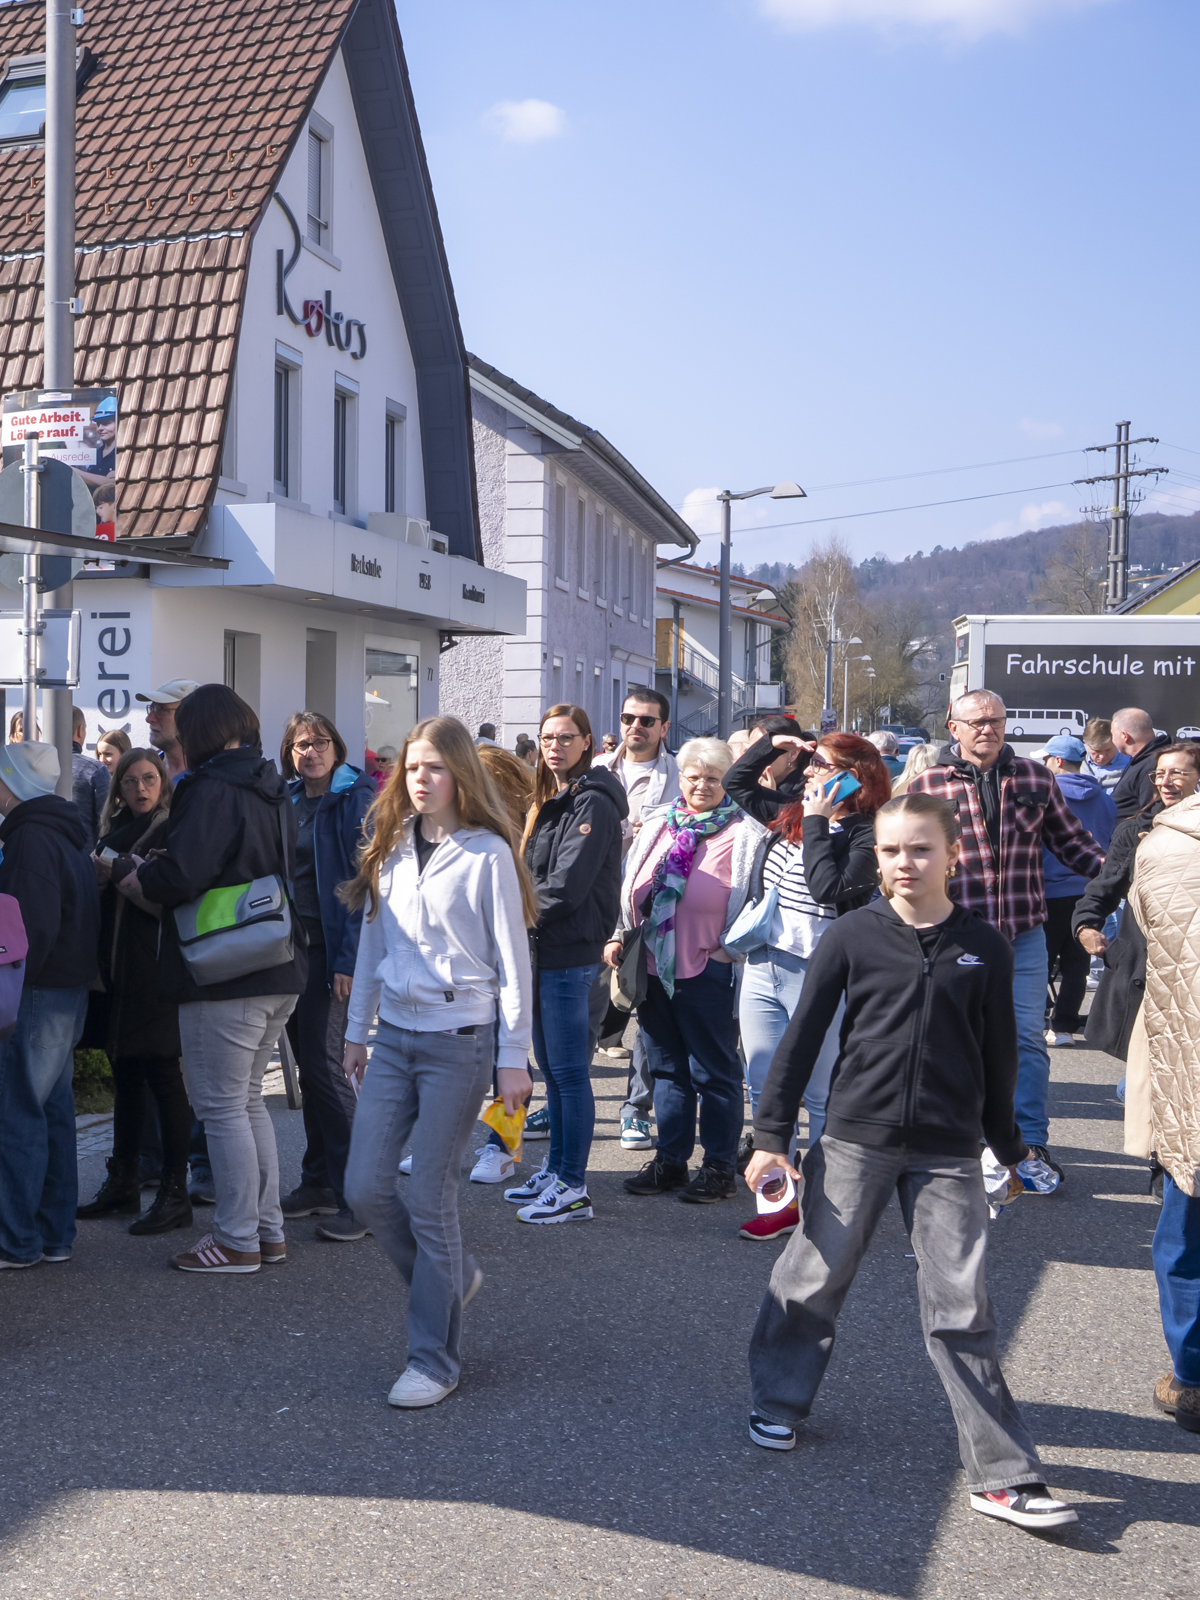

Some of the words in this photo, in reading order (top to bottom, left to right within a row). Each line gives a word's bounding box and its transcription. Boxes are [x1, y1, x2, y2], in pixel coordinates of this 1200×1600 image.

[11, 415, 37, 427] Gute
[39, 411, 85, 424] Arbeit.
[10, 429, 44, 441] Löe
[47, 426, 79, 438] rauf.
[51, 452, 92, 461] Ausrede.
[1006, 652, 1145, 676] Fahrschule
[1153, 655, 1196, 676] mit
